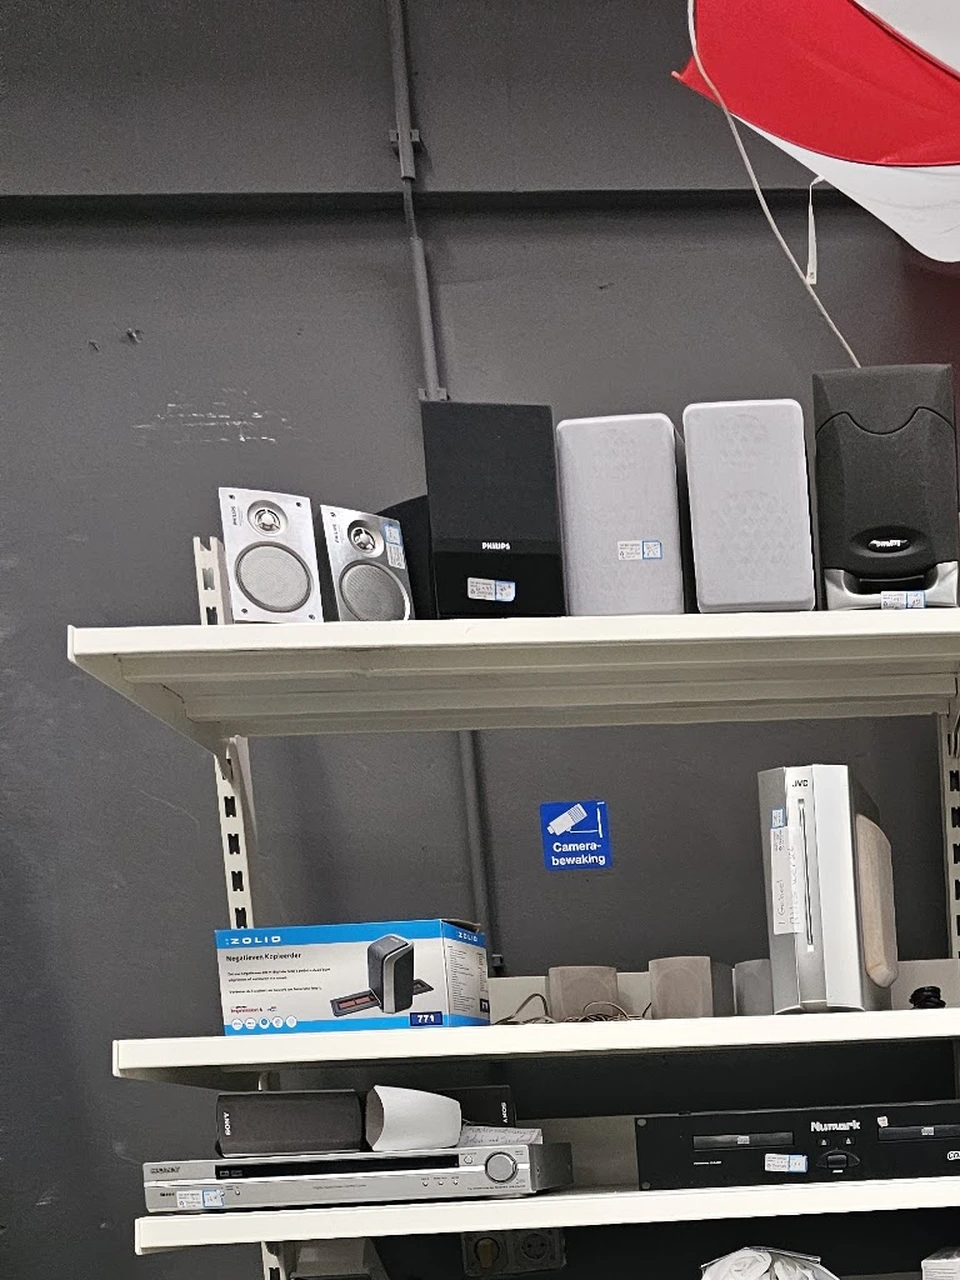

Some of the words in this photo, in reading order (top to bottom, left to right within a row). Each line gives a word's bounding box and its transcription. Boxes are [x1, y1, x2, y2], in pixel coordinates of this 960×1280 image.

[481, 541, 511, 551] PHILIPS
[791, 779, 809, 787] JVC
[552, 842, 602, 852] Camera-
[551, 854, 606, 866] bewaking
[417, 1014, 435, 1023] 771
[223, 1111, 231, 1136] SONY
[810, 1119, 861, 1132] Numark
